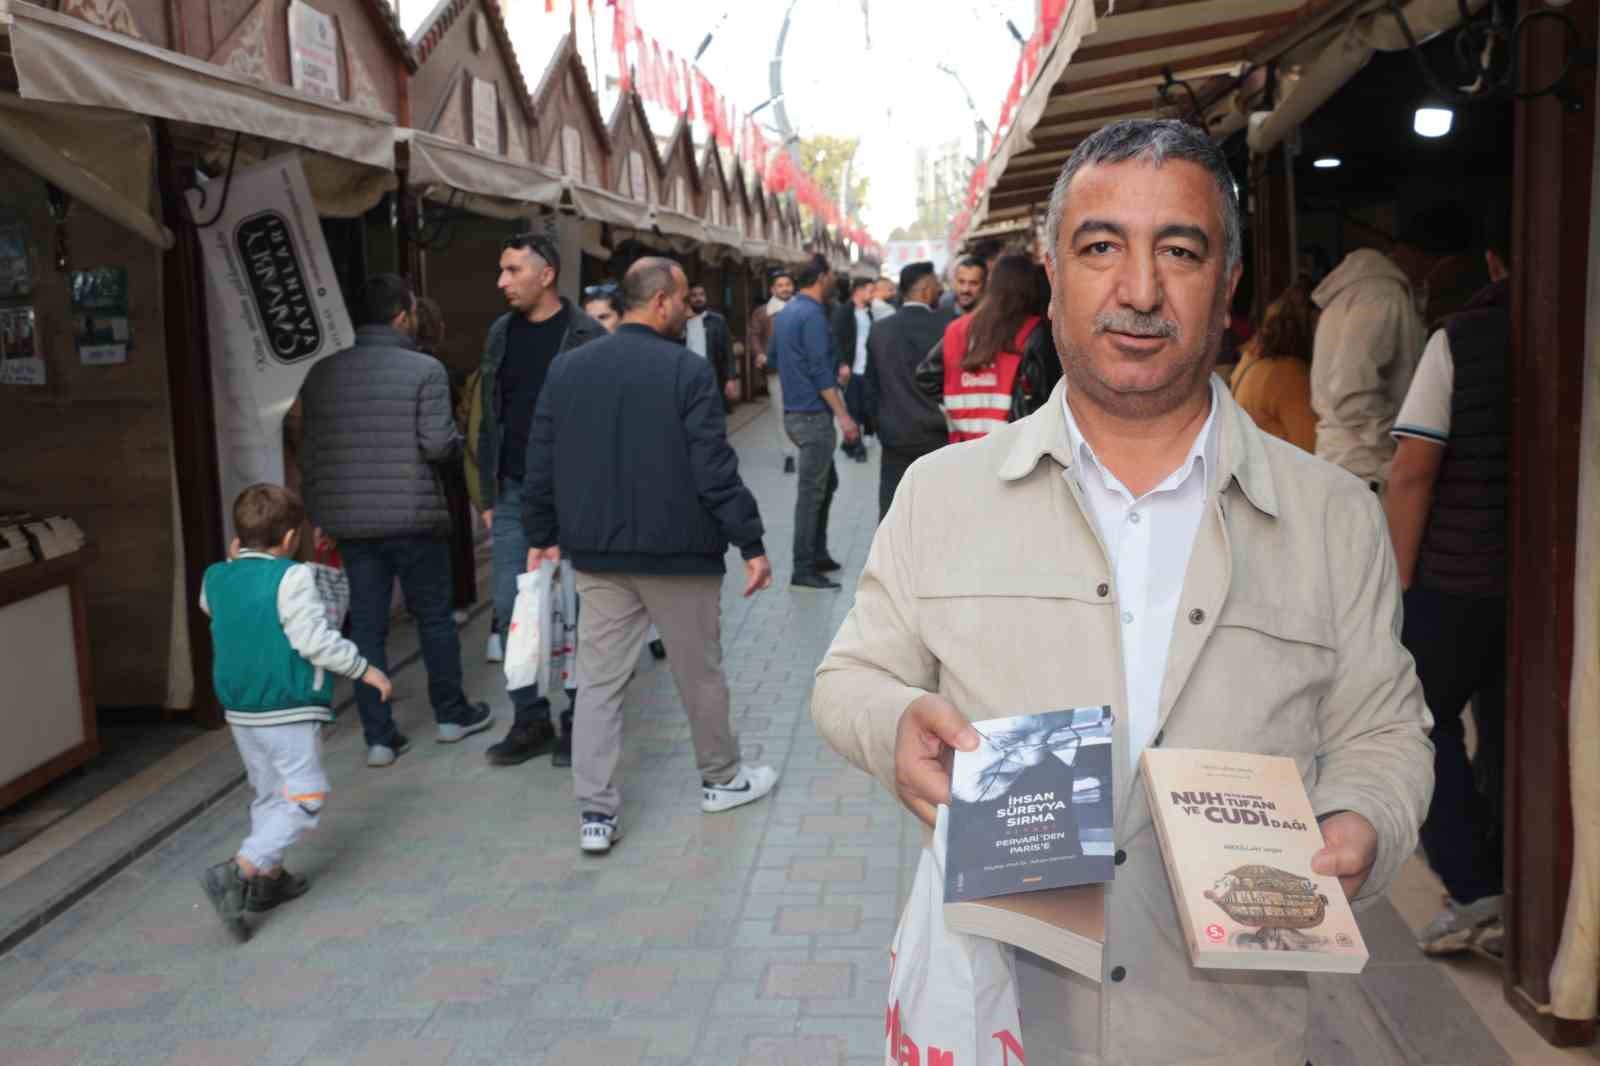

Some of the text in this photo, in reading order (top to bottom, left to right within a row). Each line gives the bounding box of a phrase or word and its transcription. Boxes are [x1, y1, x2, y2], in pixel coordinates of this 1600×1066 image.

[266, 219, 317, 345] YAYINLARI
[996, 800, 1066, 818] SÜREYYA
[1008, 792, 1054, 807] İHSAN
[1170, 791, 1225, 806] NUH
[1226, 798, 1277, 811] TUFANI
[1006, 813, 1055, 827] SIRMA
[1204, 807, 1270, 826] CUDİ
[1271, 819, 1307, 832] DAĞI
